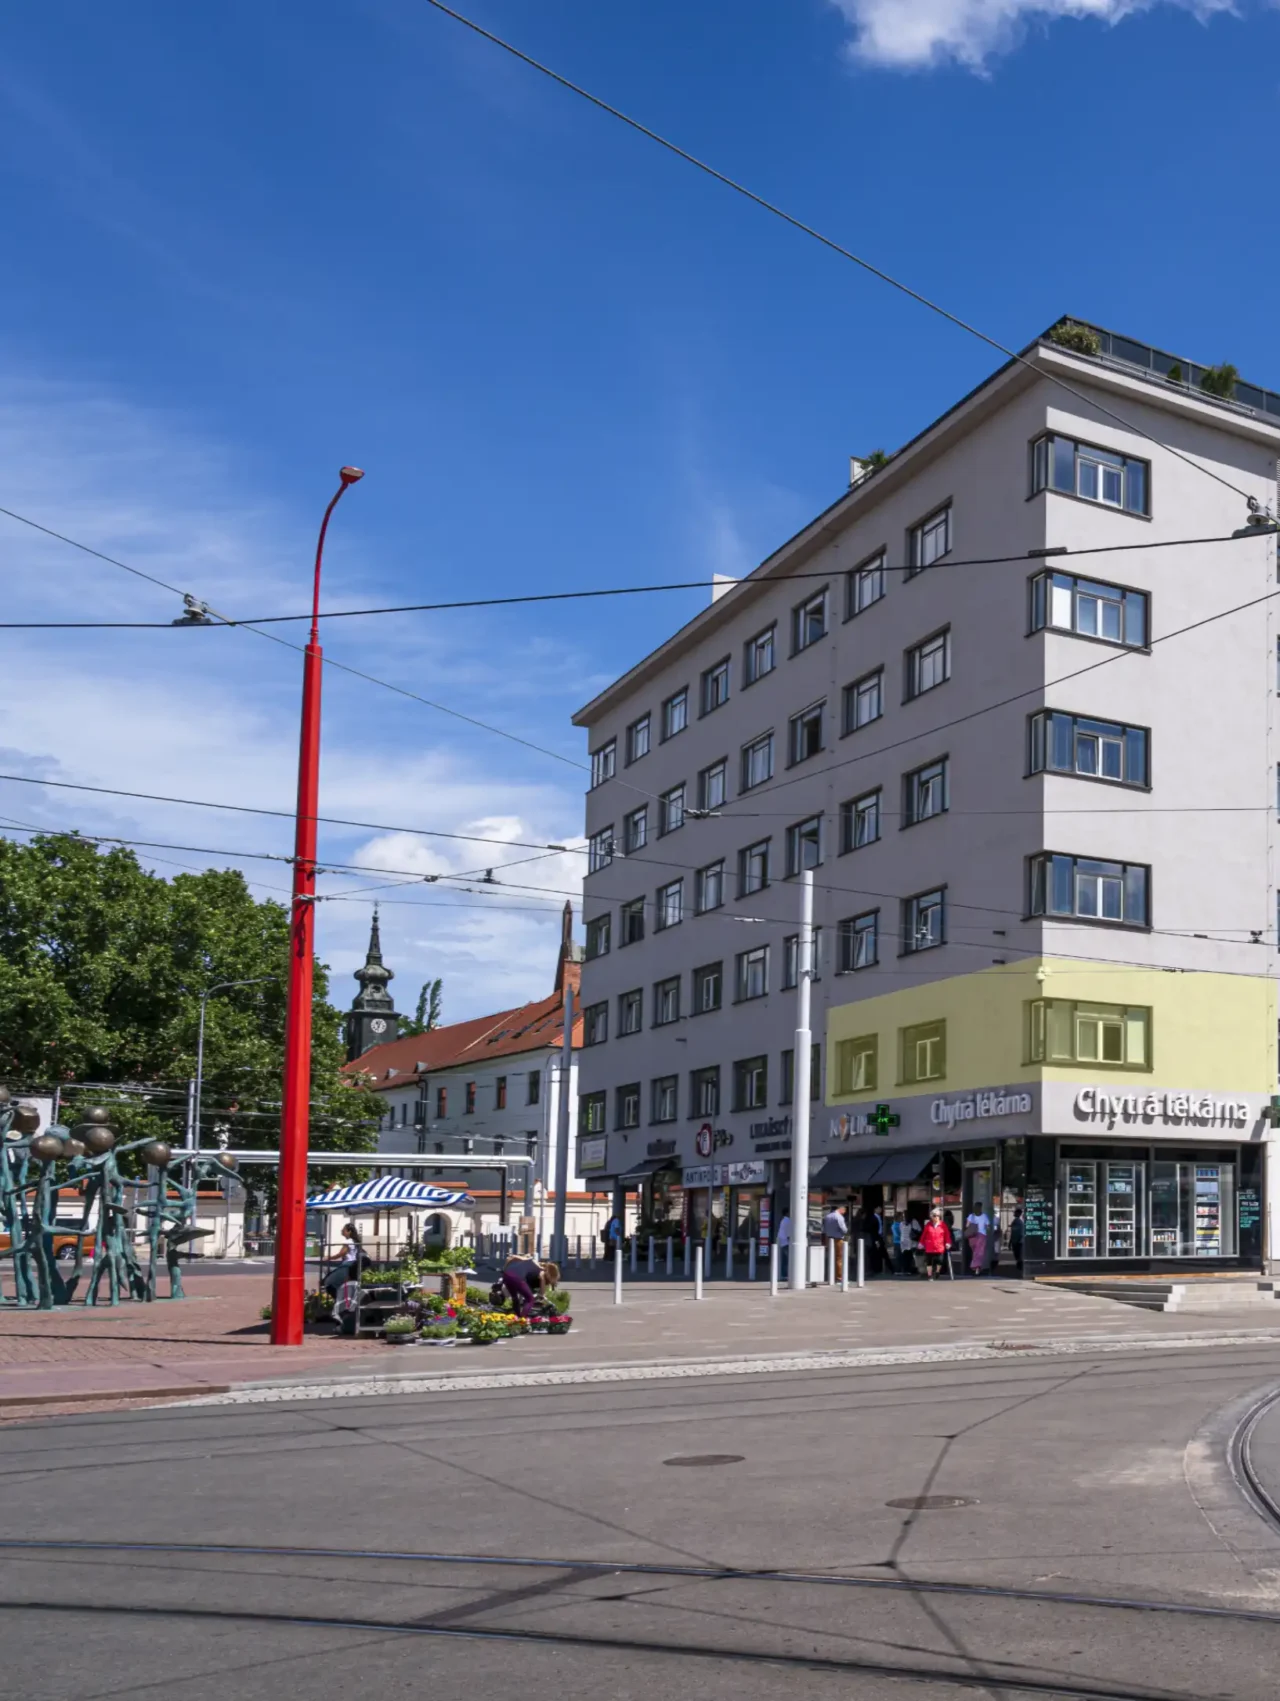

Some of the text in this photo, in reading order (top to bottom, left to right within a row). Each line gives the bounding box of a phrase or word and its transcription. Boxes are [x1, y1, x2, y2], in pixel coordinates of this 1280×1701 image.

[931, 1090, 1032, 1129] Chytrá lékárna
[1077, 1087, 1250, 1121] Chytrá lékárna
